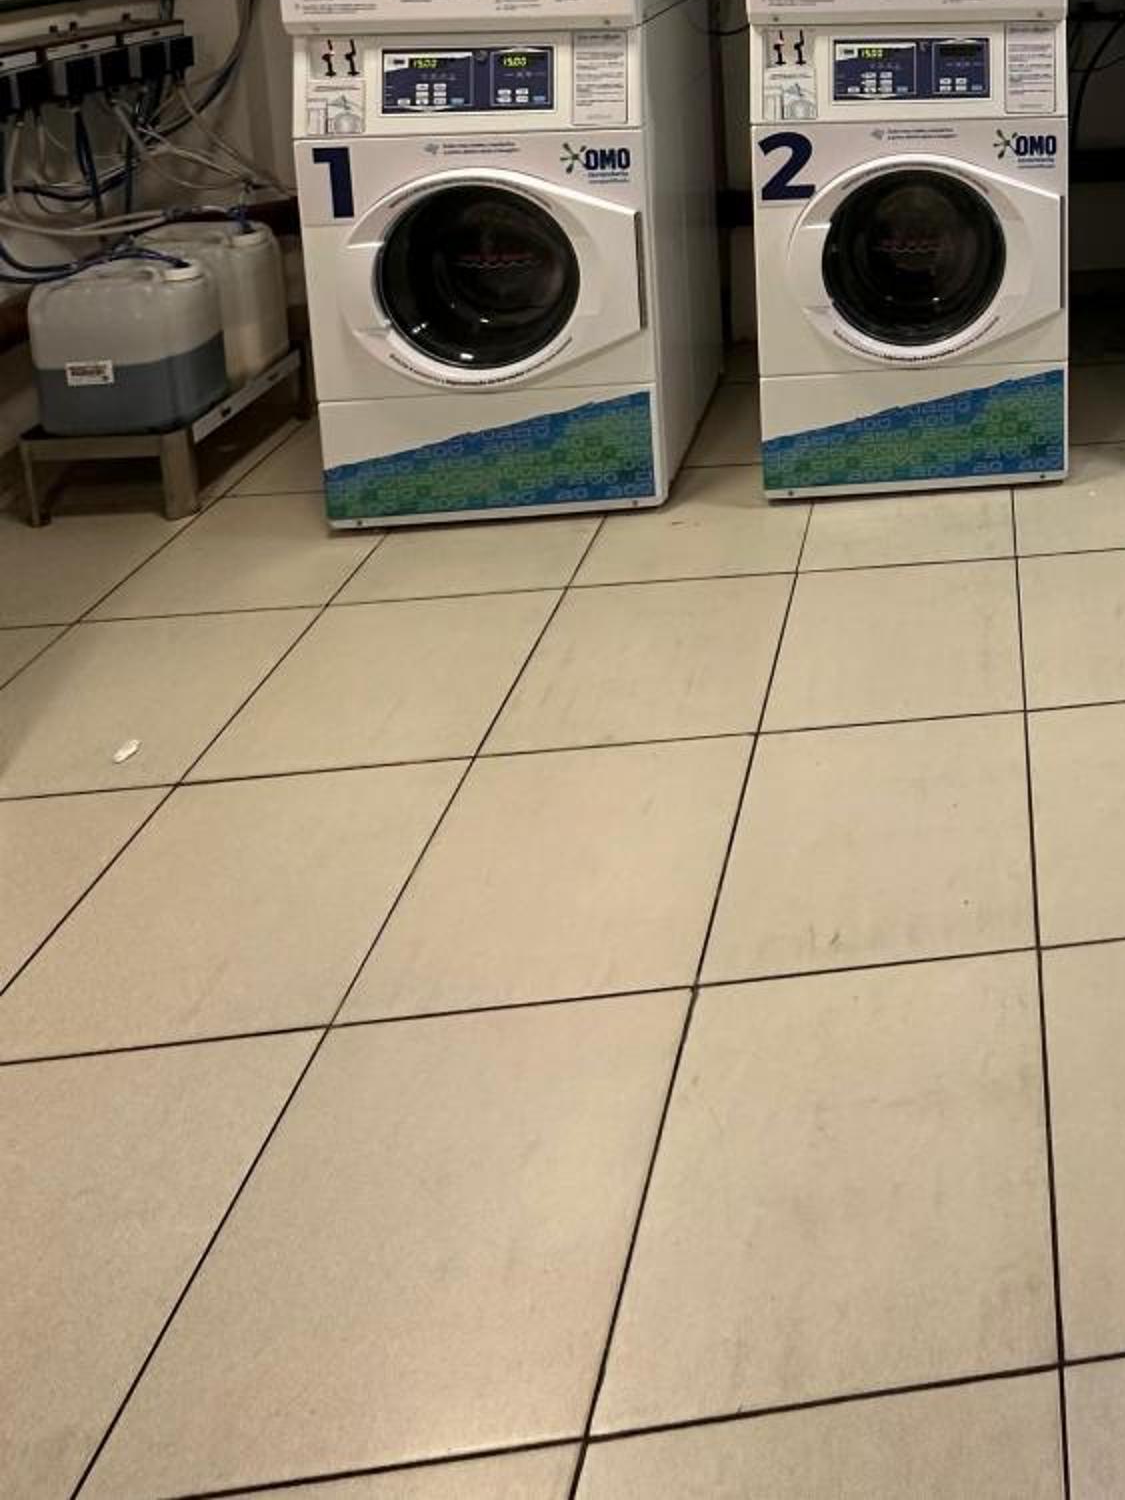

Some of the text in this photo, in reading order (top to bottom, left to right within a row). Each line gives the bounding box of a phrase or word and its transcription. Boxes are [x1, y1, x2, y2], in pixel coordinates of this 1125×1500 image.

[584, 148, 631, 170] OMO
[758, 132, 816, 200] 2
[1015, 135, 1057, 156] OMO
[312, 147, 354, 218] 1
